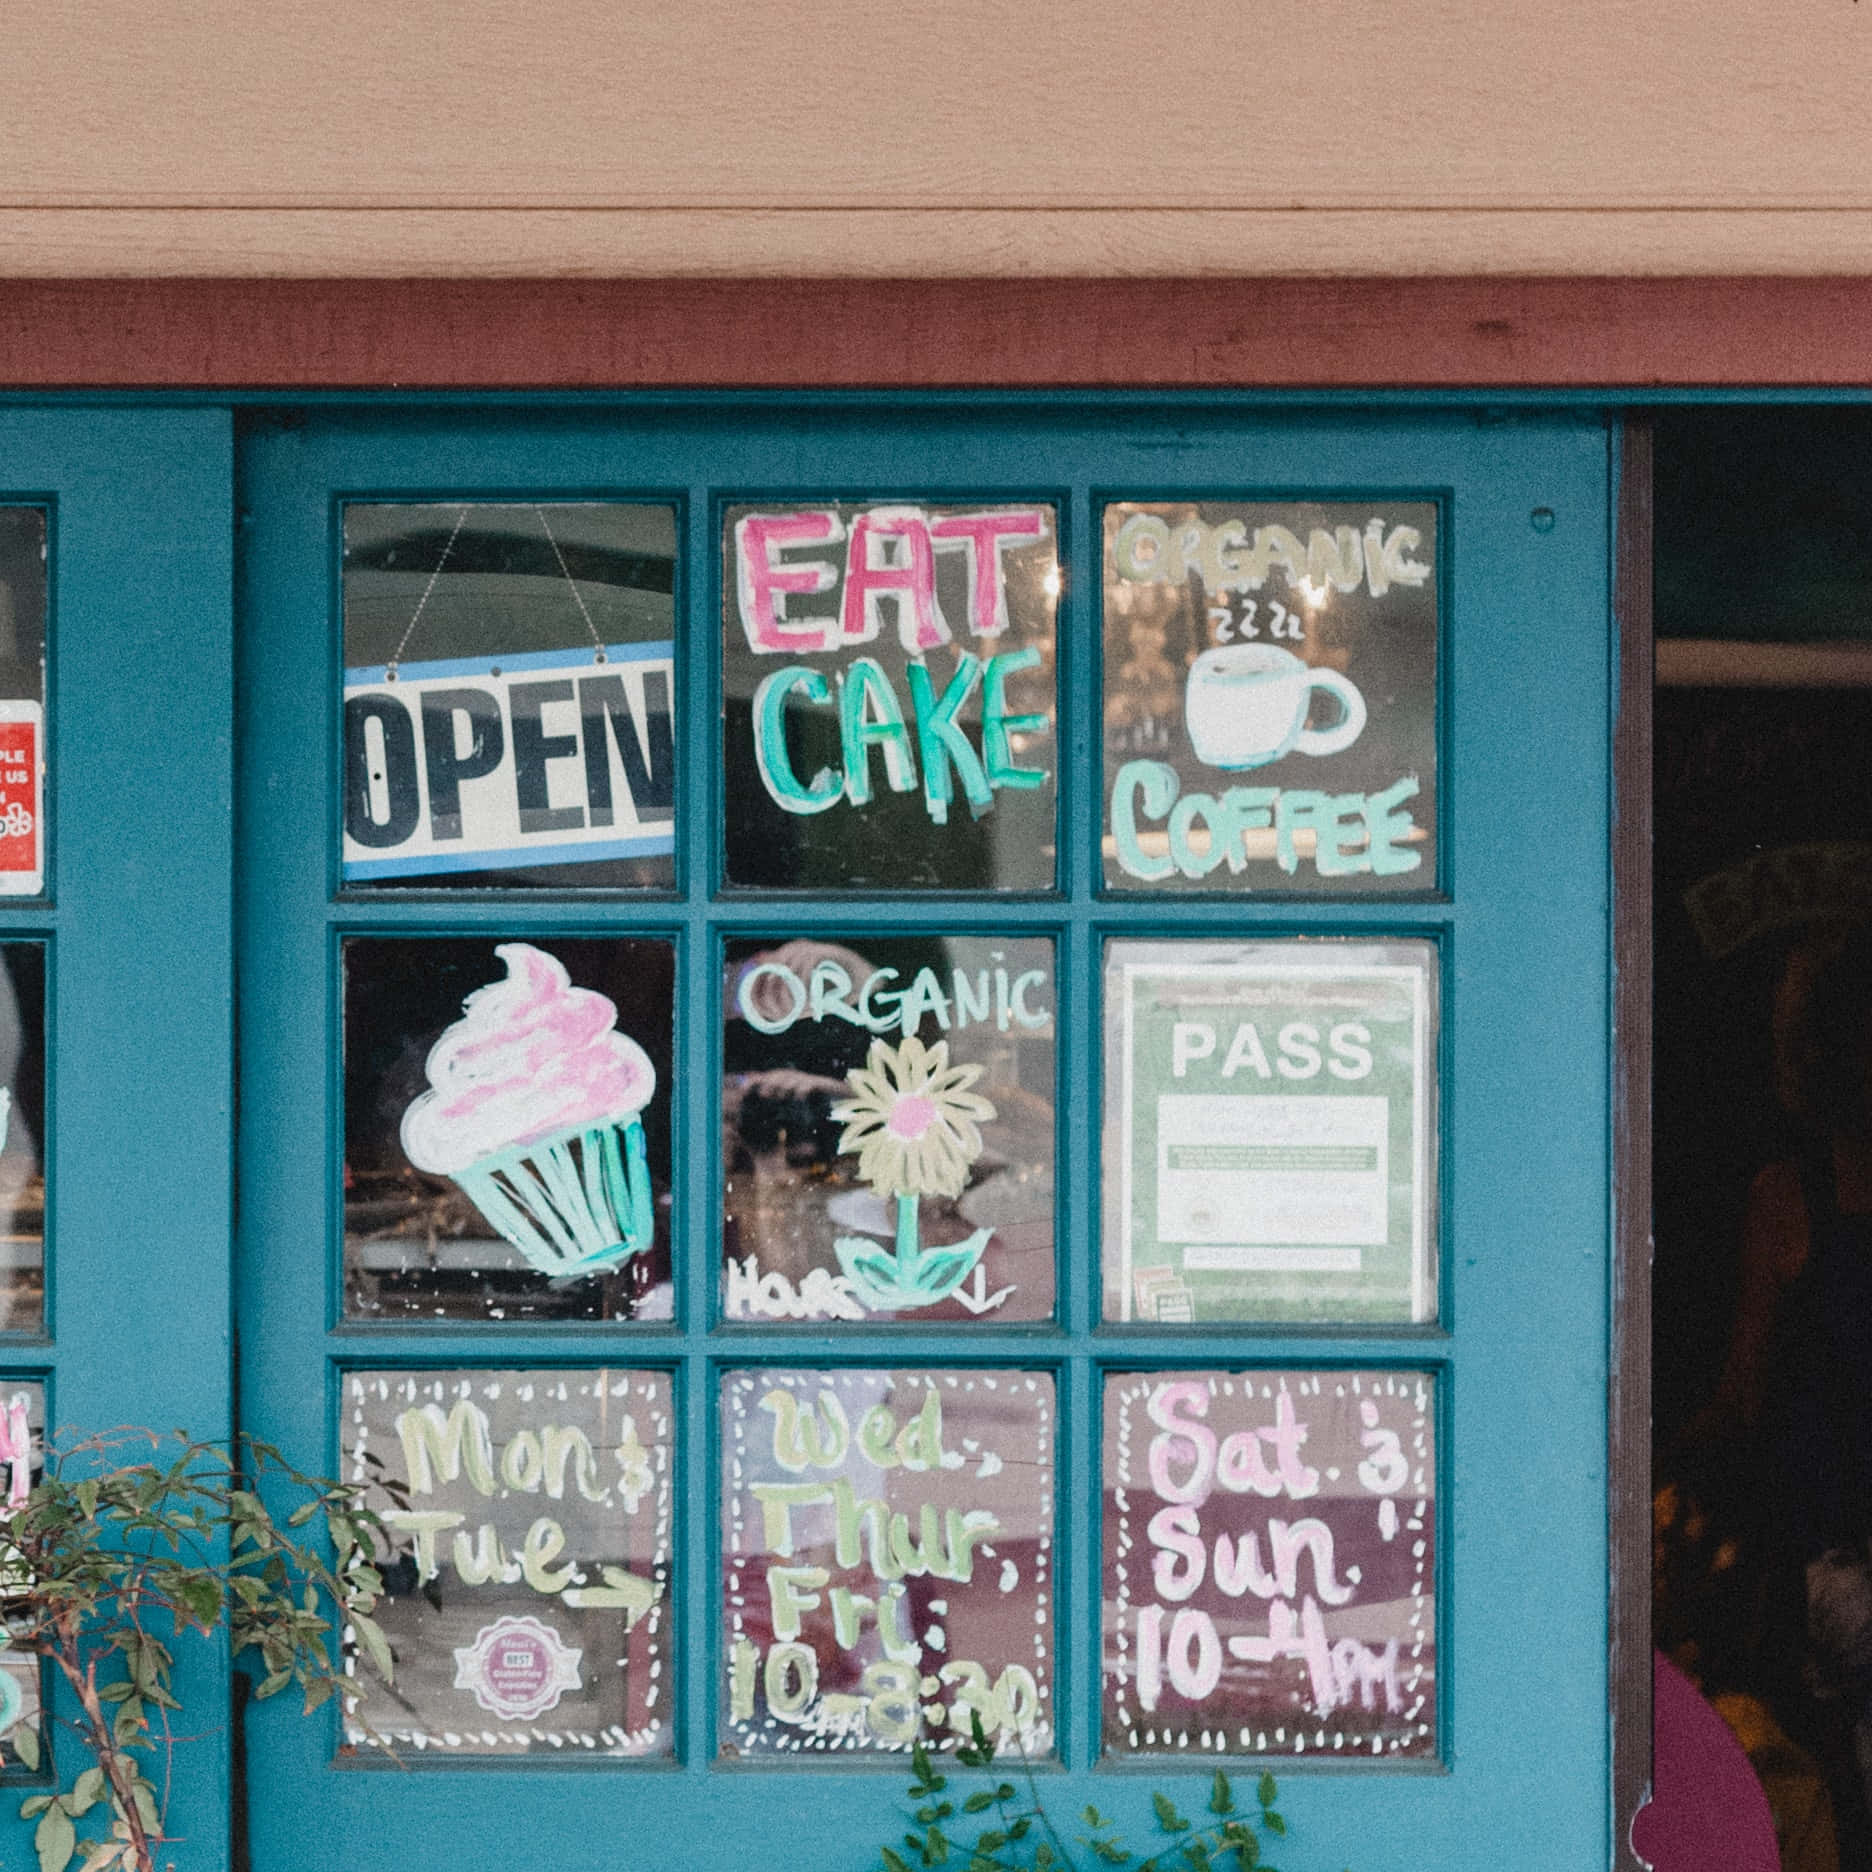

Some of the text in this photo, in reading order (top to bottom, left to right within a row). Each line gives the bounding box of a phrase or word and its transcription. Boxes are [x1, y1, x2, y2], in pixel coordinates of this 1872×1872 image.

[735, 505, 1049, 655] EAT
[5, 770, 29, 784] US
[345, 669, 674, 849] OPEN
[752, 645, 1051, 824] CAKE
[1110, 759, 1422, 881] COFFEE
[1172, 1021, 1374, 1081] PASS
